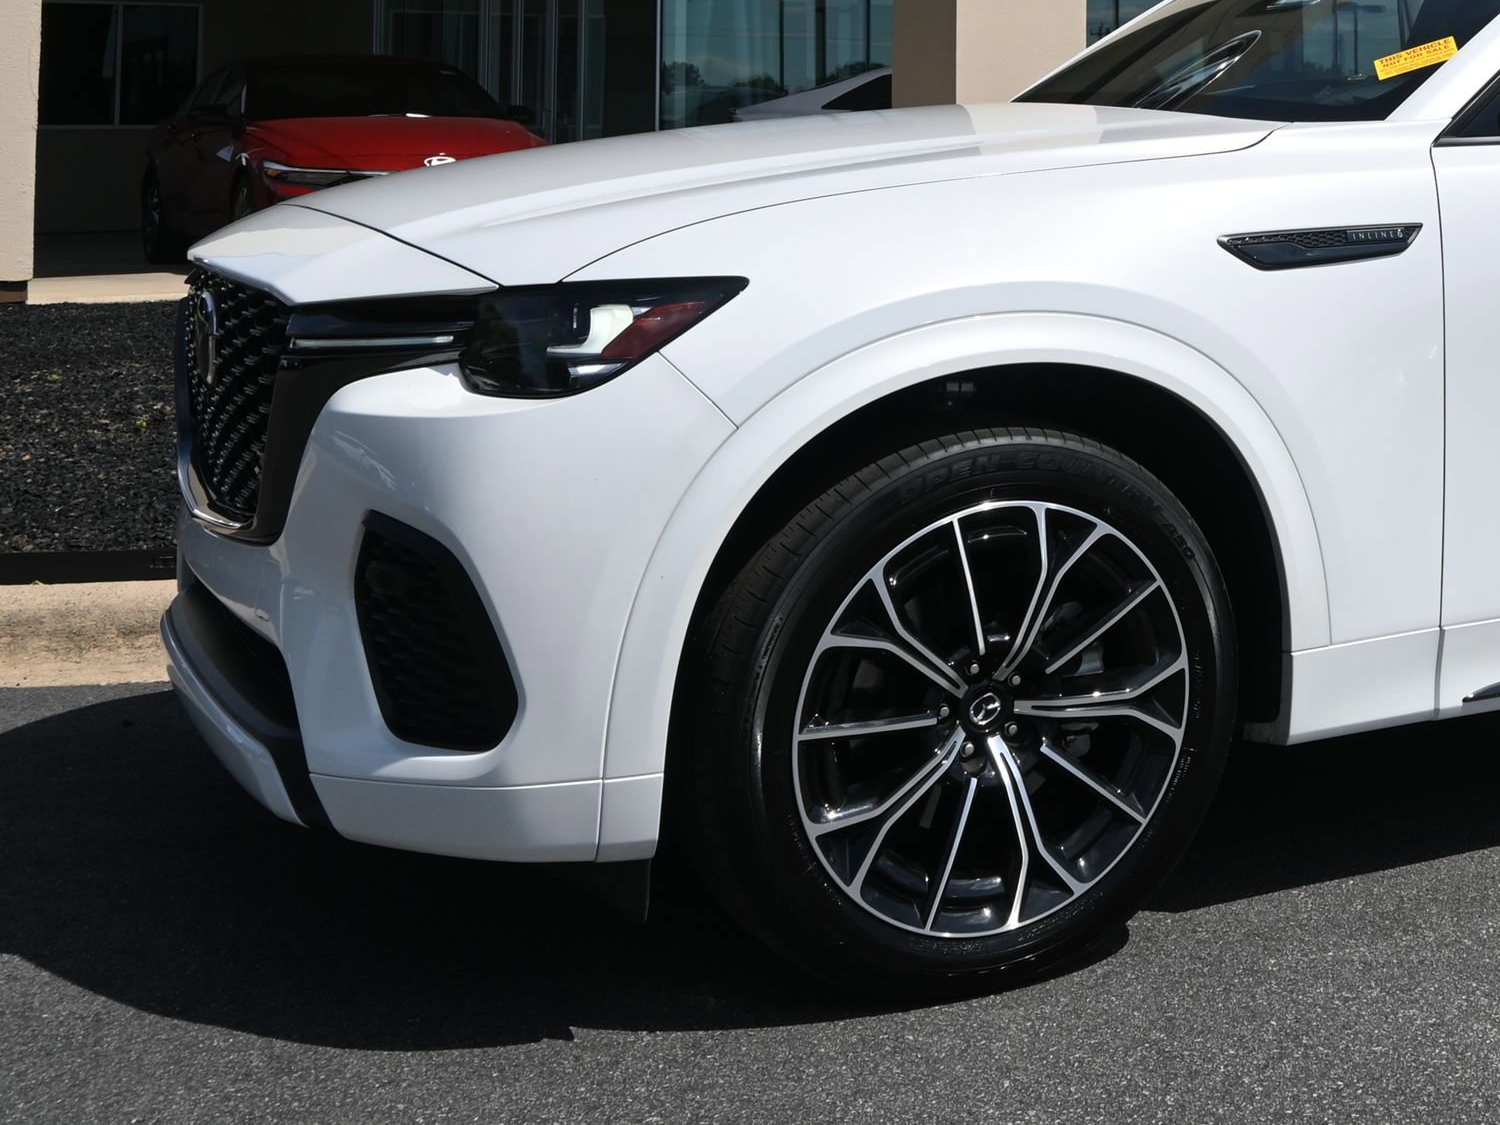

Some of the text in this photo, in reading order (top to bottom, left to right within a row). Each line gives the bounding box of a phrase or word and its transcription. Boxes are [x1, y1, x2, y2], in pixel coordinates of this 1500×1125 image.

[1380, 53, 1403, 65] THIS
[1404, 38, 1451, 56] VEHICLE
[1382, 44, 1450, 68] NOT FOR SALE
[897, 453, 1001, 501] OPEN
